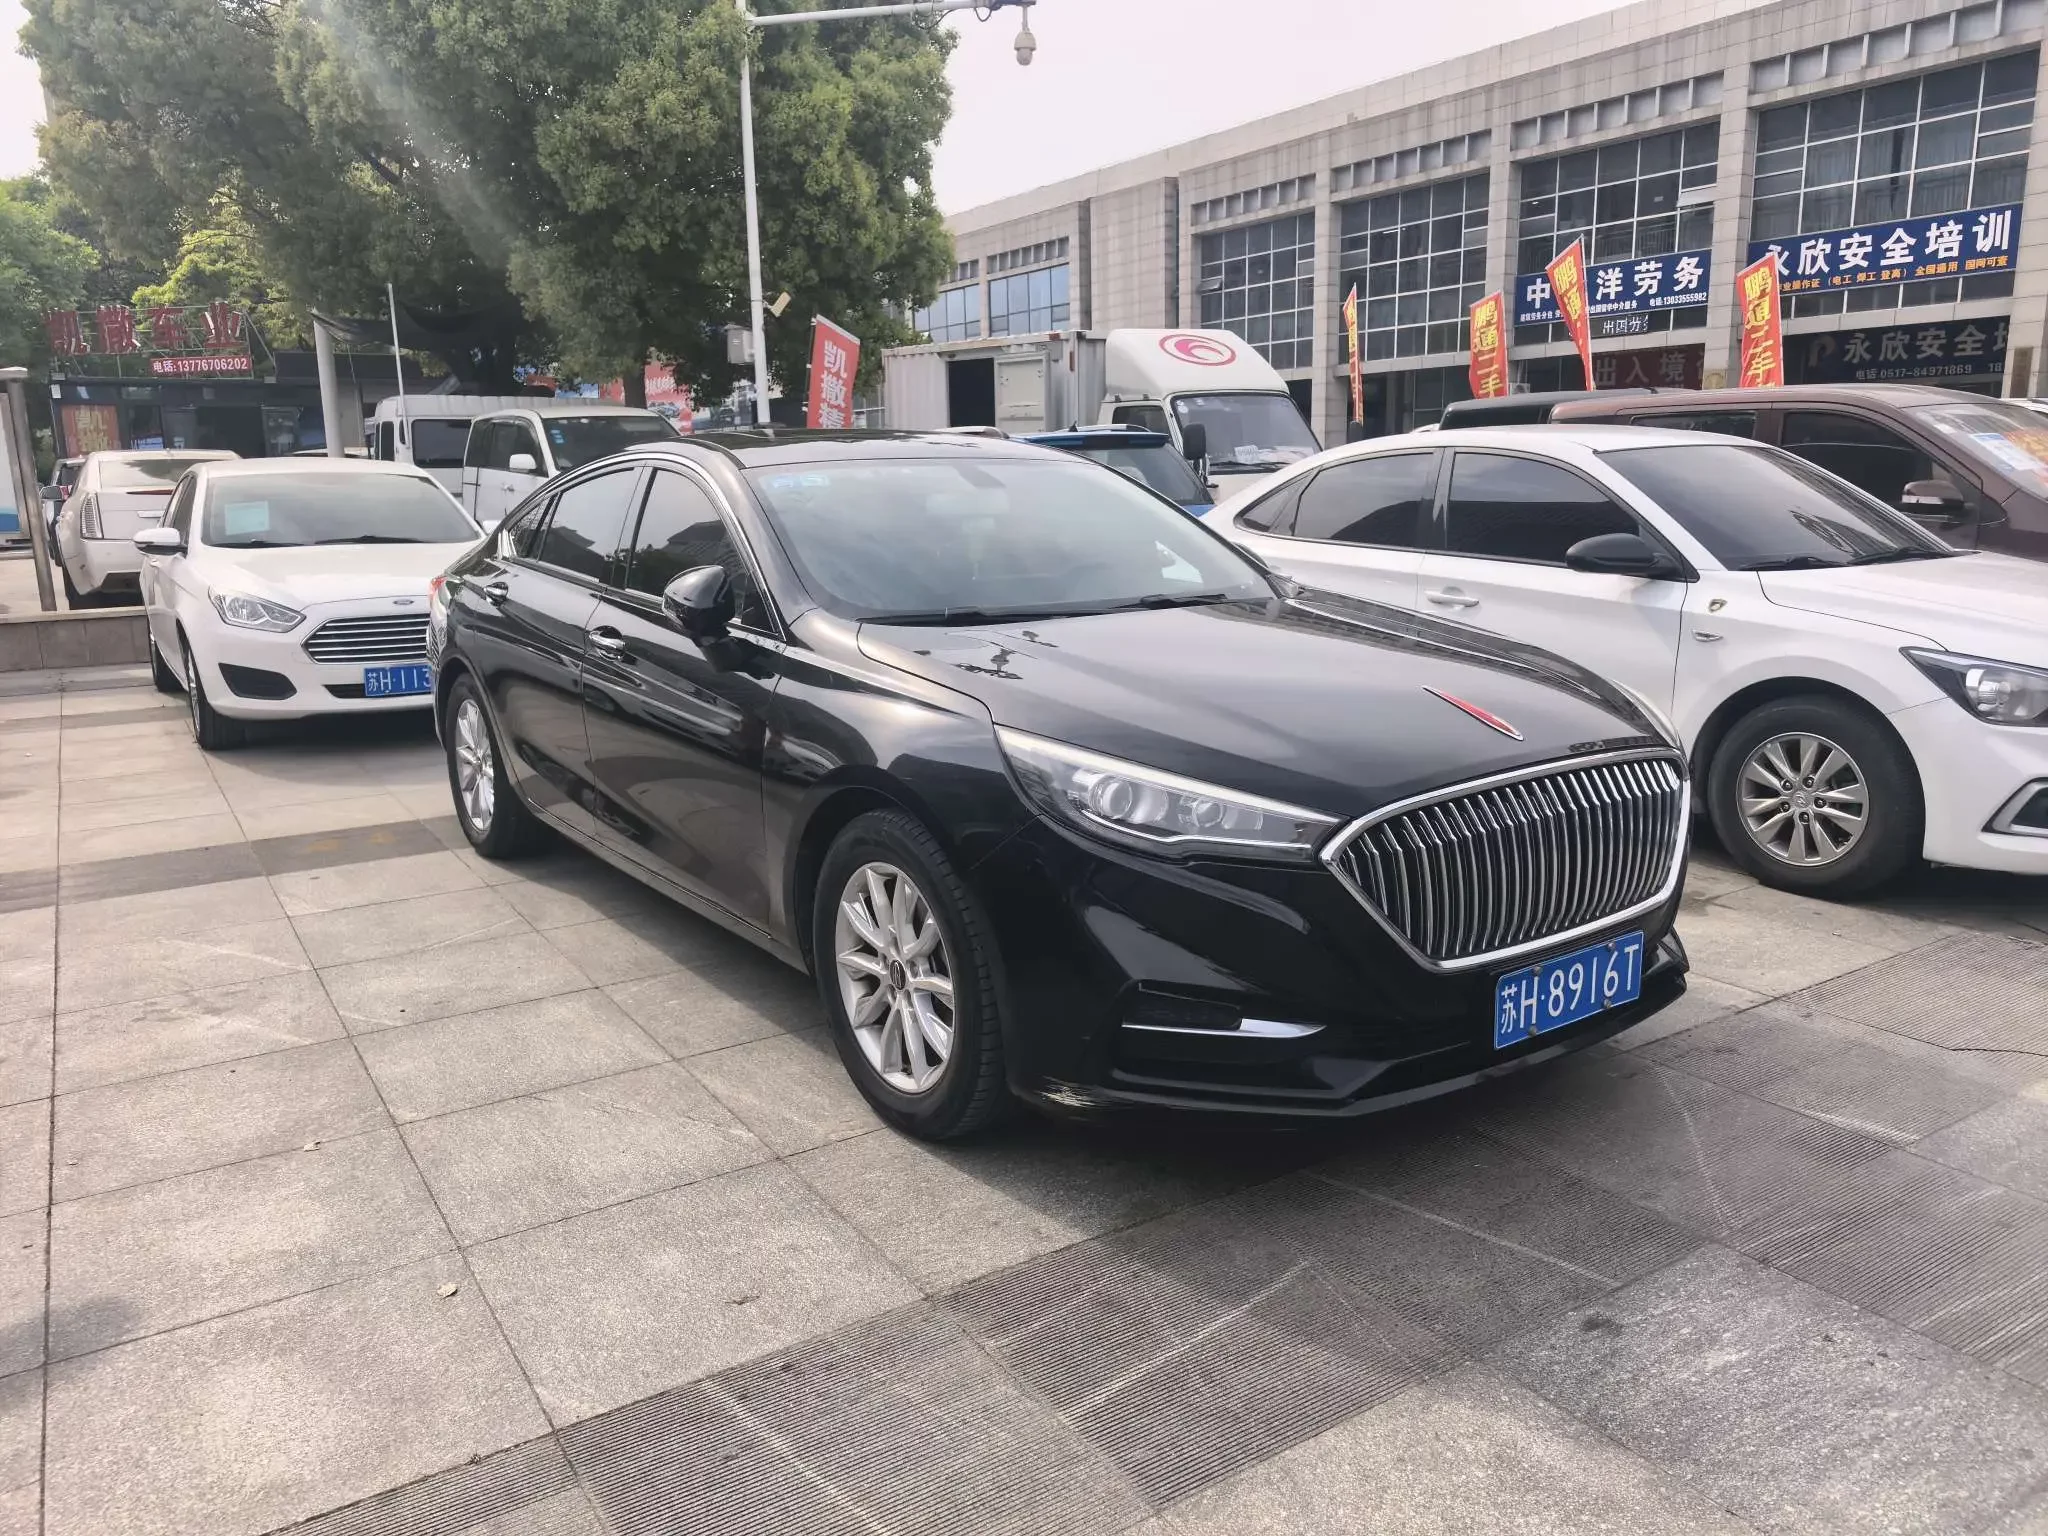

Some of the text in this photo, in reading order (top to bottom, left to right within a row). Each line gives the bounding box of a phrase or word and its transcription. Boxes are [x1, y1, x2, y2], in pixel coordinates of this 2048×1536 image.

[1764, 210, 2012, 276] 永欣安全培训
[1526, 256, 1704, 309] 中洋劳务
[1501, 944, 1640, 1035] 苏H·8916T
